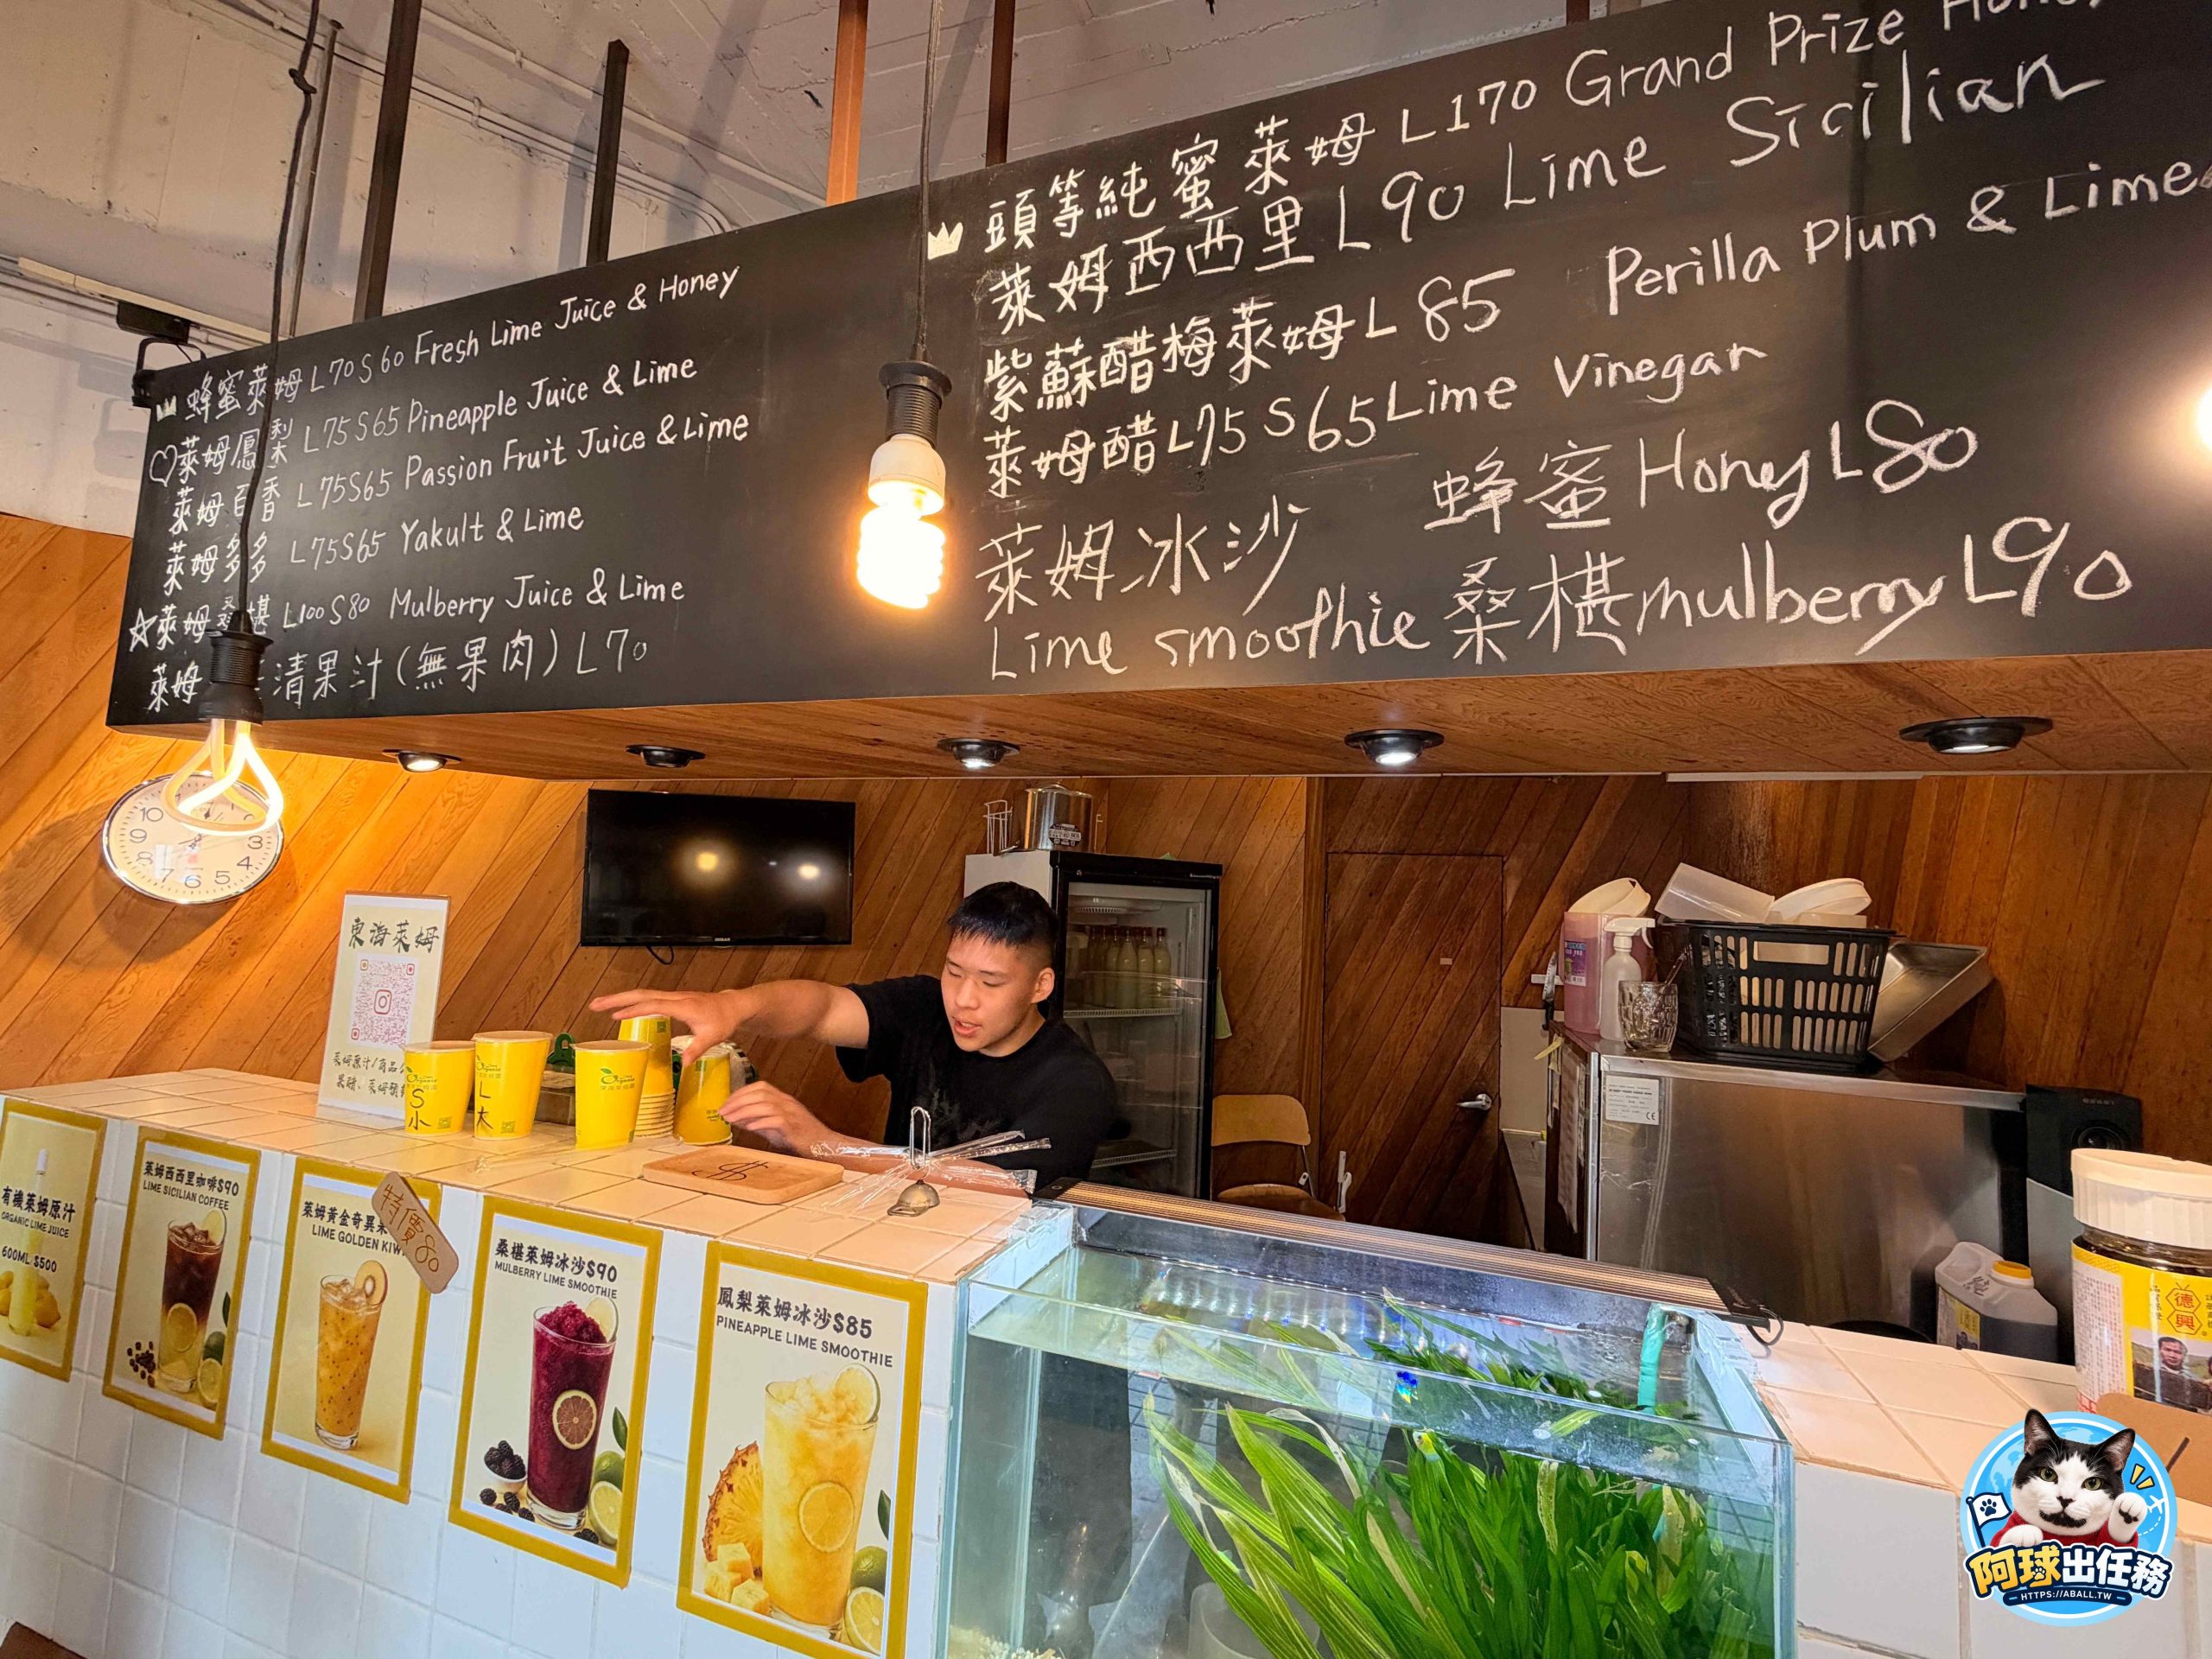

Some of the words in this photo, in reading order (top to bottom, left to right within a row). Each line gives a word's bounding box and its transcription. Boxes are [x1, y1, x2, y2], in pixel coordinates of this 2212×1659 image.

[984, 112, 1376, 253] 頭等純蜜萊姆
[1566, 26, 1732, 107] Grand
[1769, 10, 1904, 66] Prize
[989, 195, 1315, 335] 萊姆西西里
[1505, 136, 1666, 210] Lime
[1726, 49, 2106, 167] Sicilian
[984, 296, 1356, 423] 紫蘇醋梅萊姆
[1606, 232, 1780, 315] Perilla
[1802, 213, 1937, 264] Plum
[1966, 185, 2017, 235] &
[2044, 162, 2197, 219] Lime
[185, 363, 302, 423] 蜂蜜萊姆
[415, 329, 480, 365] Fresh
[491, 320, 542, 346] Lime
[555, 296, 616, 329] Juice
[627, 283, 647, 311] &
[659, 265, 741, 302] Honey
[407, 389, 517, 435] Pineapple
[527, 377, 589, 410] Juice
[603, 363, 624, 397] &
[633, 358, 698, 388] Lime
[983, 410, 1158, 499] 萊姆醋
[1387, 375, 1517, 422] Lime
[1554, 342, 1769, 404] Vinegar
[168, 476, 281, 535] 萊姆百香
[405, 454, 492, 490] Passion
[504, 438, 567, 472] Fruit
[578, 424, 645, 458] Juice
[657, 413, 677, 445] &
[684, 411, 750, 442] Lime
[1423, 439, 1614, 535] 蜂蜜
[1638, 426, 1812, 530] Honey
[163, 531, 269, 596] 萊姆多多
[401, 512, 484, 555] Yakult
[497, 507, 514, 543] &
[524, 505, 584, 533] Lime
[975, 493, 1312, 623] 萊姆冰沙
[389, 585, 494, 623] Mulberry
[505, 575, 573, 608] Juice
[587, 568, 607, 607] &
[620, 572, 685, 602] Lime
[992, 626, 1128, 681] Lime
[1154, 582, 1432, 669] smoothie
[348, 917, 440, 954] 東海萊姆
[410, 1089, 424, 1109] S
[480, 1080, 491, 1098] L
[408, 1110, 431, 1130] 小
[1, 1185, 76, 1224] 有機萊姆原汁
[143, 1179, 162, 1193] LIME
[162, 1184, 197, 1204] SICILIAN
[198, 1193, 229, 1211] COFFEE
[1, 1211, 30, 1228] ORGANIC
[29, 1219, 48, 1233] LIME
[48, 1224, 70, 1238] JUICE
[311, 1224, 335, 1240] LIME
[338, 1230, 379, 1250] GOLDEN
[381, 1239, 406, 1256] KIW
[1, 1245, 31, 1267] 600ML
[494, 1260, 542, 1281] MULBERRY
[543, 1274, 566, 1287] LIME
[567, 1281, 618, 1300] SMOOTHIE
[716, 1315, 783, 1342] PINEAPPLE
[785, 1331, 817, 1351] LIME
[821, 1340, 893, 1368] SMOOTHIE
